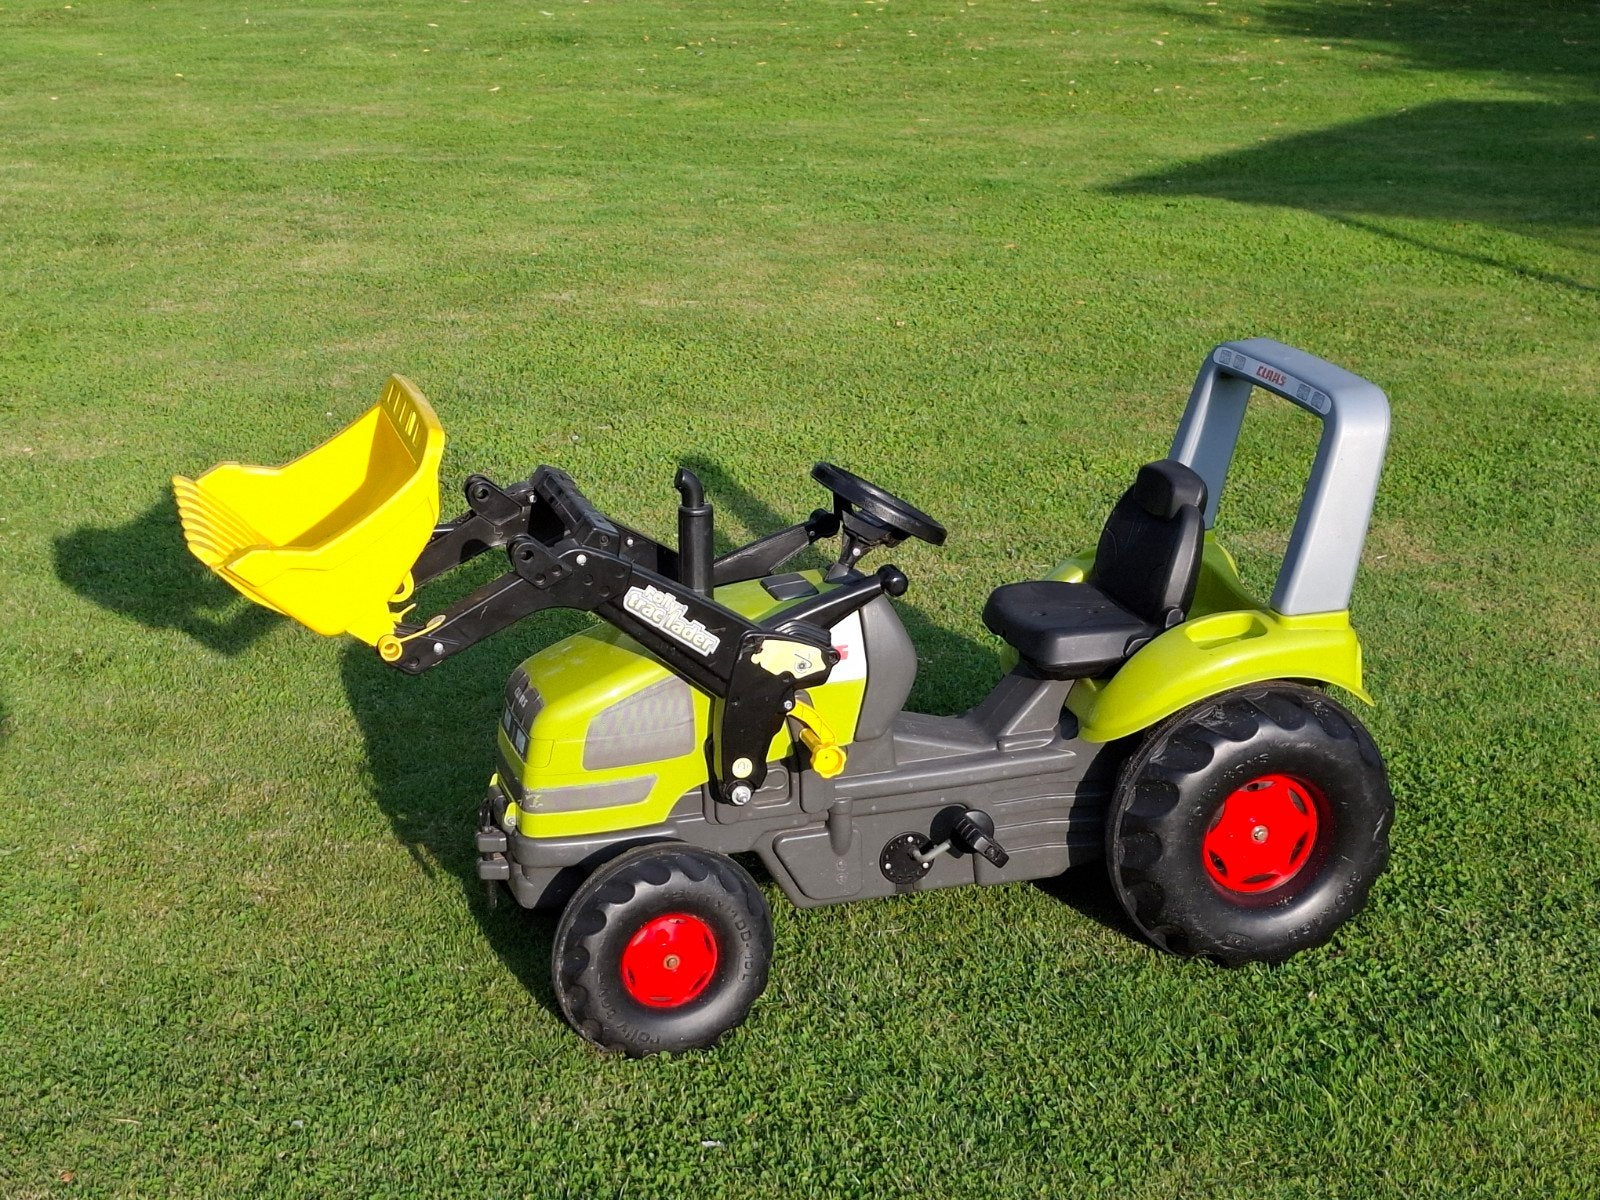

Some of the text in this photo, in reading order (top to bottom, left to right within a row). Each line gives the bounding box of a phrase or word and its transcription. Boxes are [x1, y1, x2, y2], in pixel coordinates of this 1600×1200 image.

[1256, 364, 1287, 386] CLAAS
[643, 585, 681, 615] rolly
[627, 592, 714, 651] trac lader
